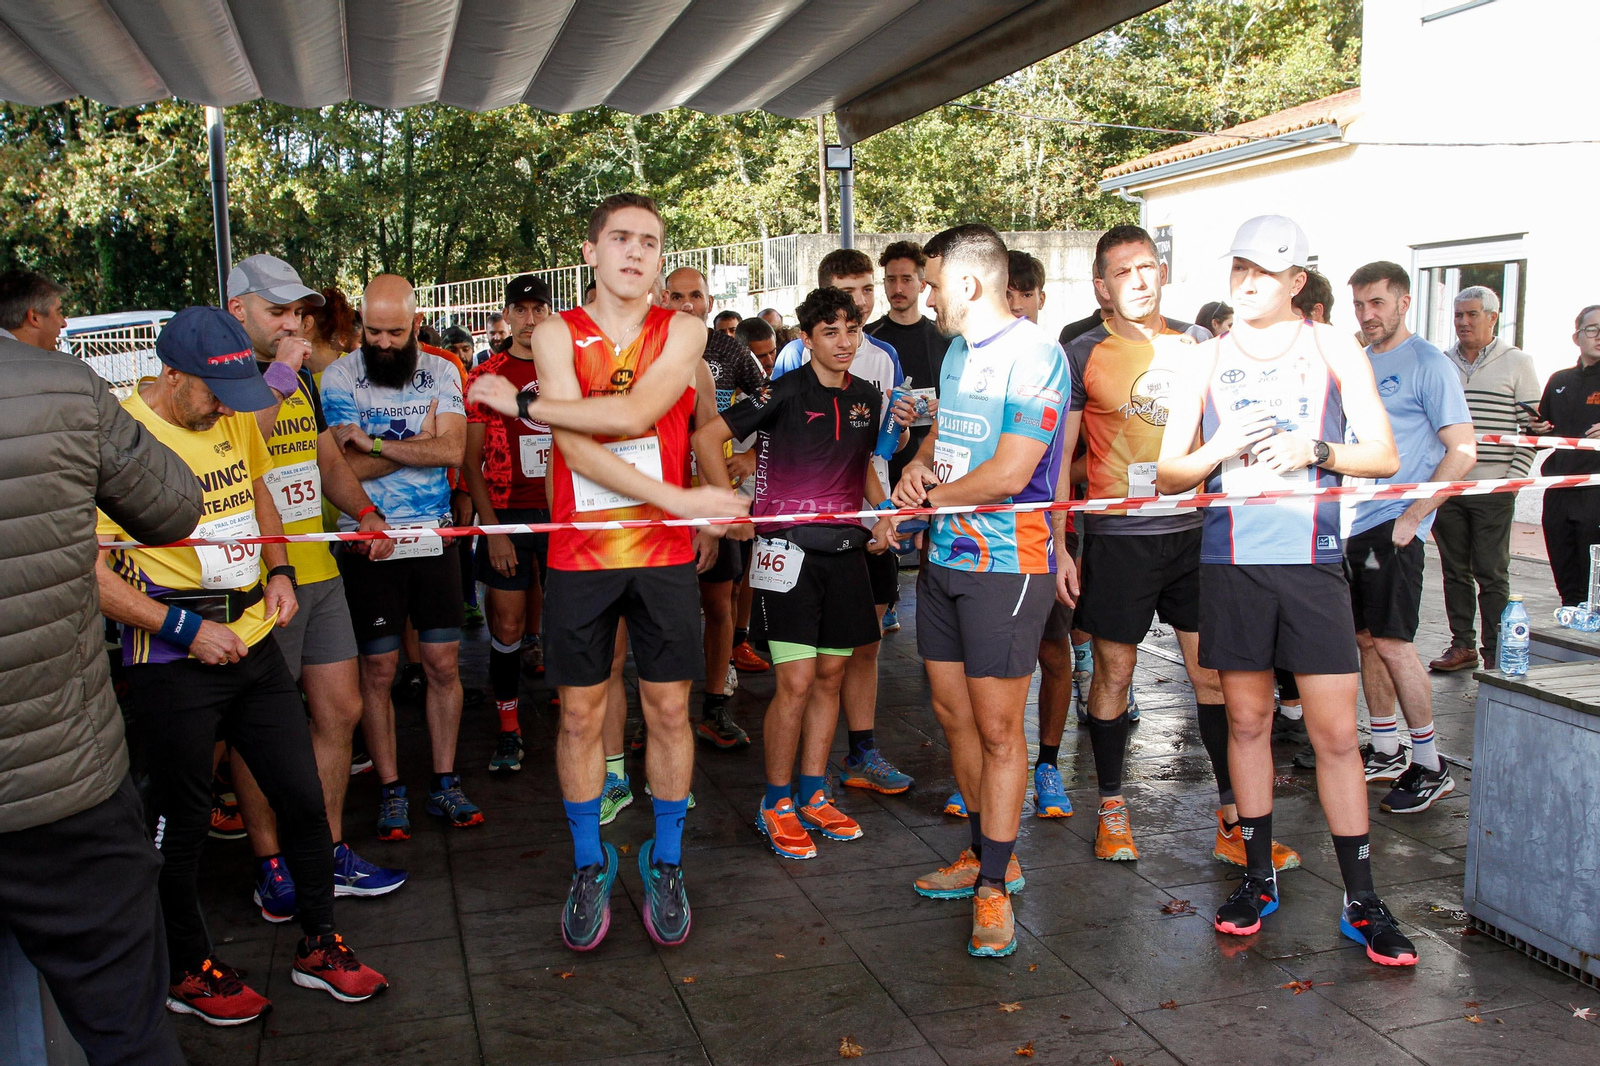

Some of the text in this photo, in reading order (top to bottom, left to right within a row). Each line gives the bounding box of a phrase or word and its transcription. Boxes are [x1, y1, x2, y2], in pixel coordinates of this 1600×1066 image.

[940, 415, 982, 436] PLASTIFER
[281, 480, 316, 506] 133
[214, 519, 229, 530] TRAIL
[756, 551, 787, 573] 146
